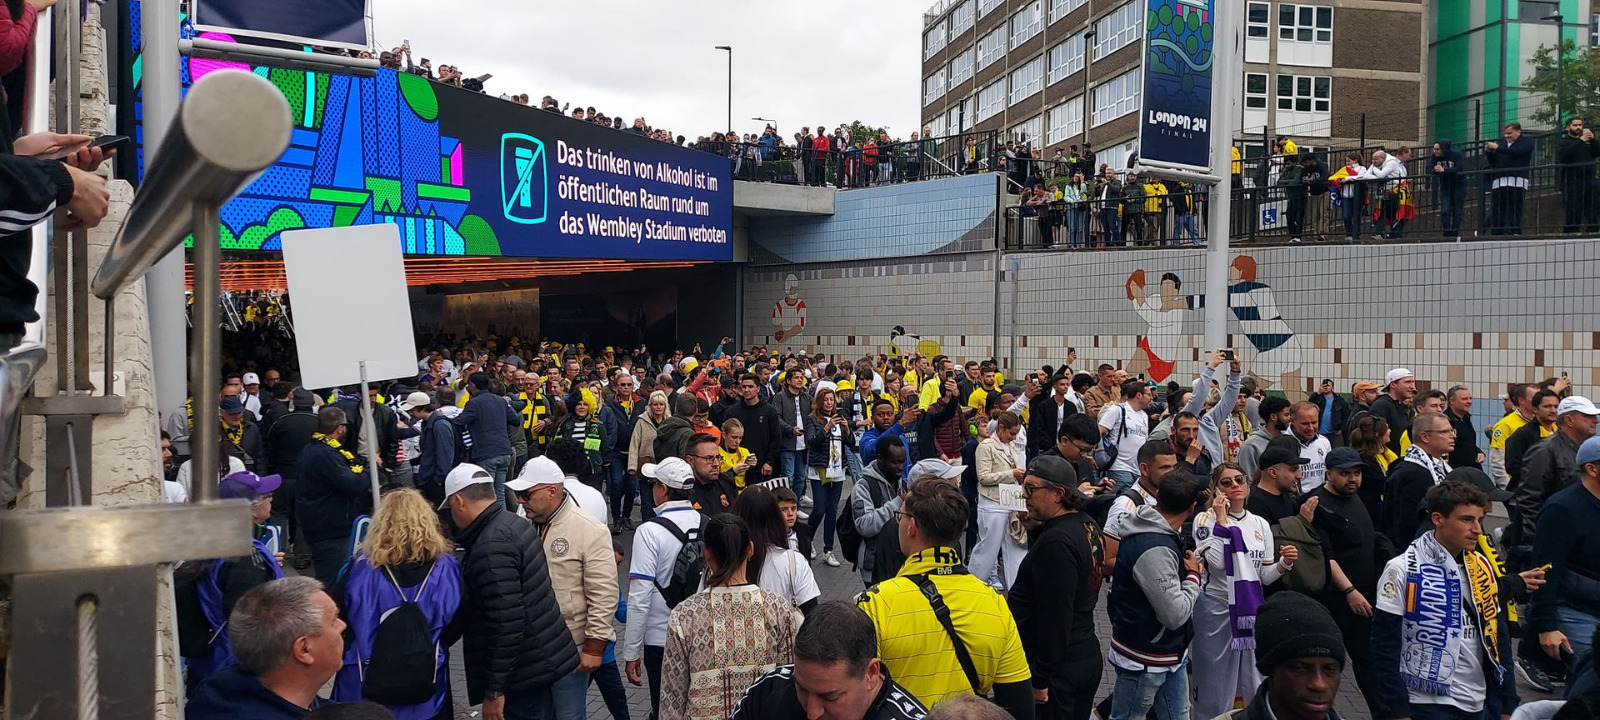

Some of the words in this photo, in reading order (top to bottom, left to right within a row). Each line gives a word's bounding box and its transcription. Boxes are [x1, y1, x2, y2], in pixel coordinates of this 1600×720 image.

[1161, 129, 1193, 139] FINAL
[1192, 117, 1207, 132] 24
[557, 139, 583, 168] Das
[586, 147, 631, 176] trinken
[634, 160, 654, 180] von
[656, 162, 693, 187] Alkohol
[694, 169, 706, 189] ist
[707, 172, 718, 192] im
[558, 174, 637, 208] öffentlichen
[640, 188, 670, 212] Raum
[671, 196, 693, 215] rund
[695, 200, 709, 216] um
[559, 211, 584, 235] das
[586, 213, 643, 244] Wembley
[645, 218, 687, 242] Stadium
[688, 224, 727, 244] verboten
[1300, 462, 1326, 471] mirates
[937, 566, 952, 575] BVB
[1407, 549, 1418, 580] FINAL
[1450, 581, 1460, 627] WEMBLEY
